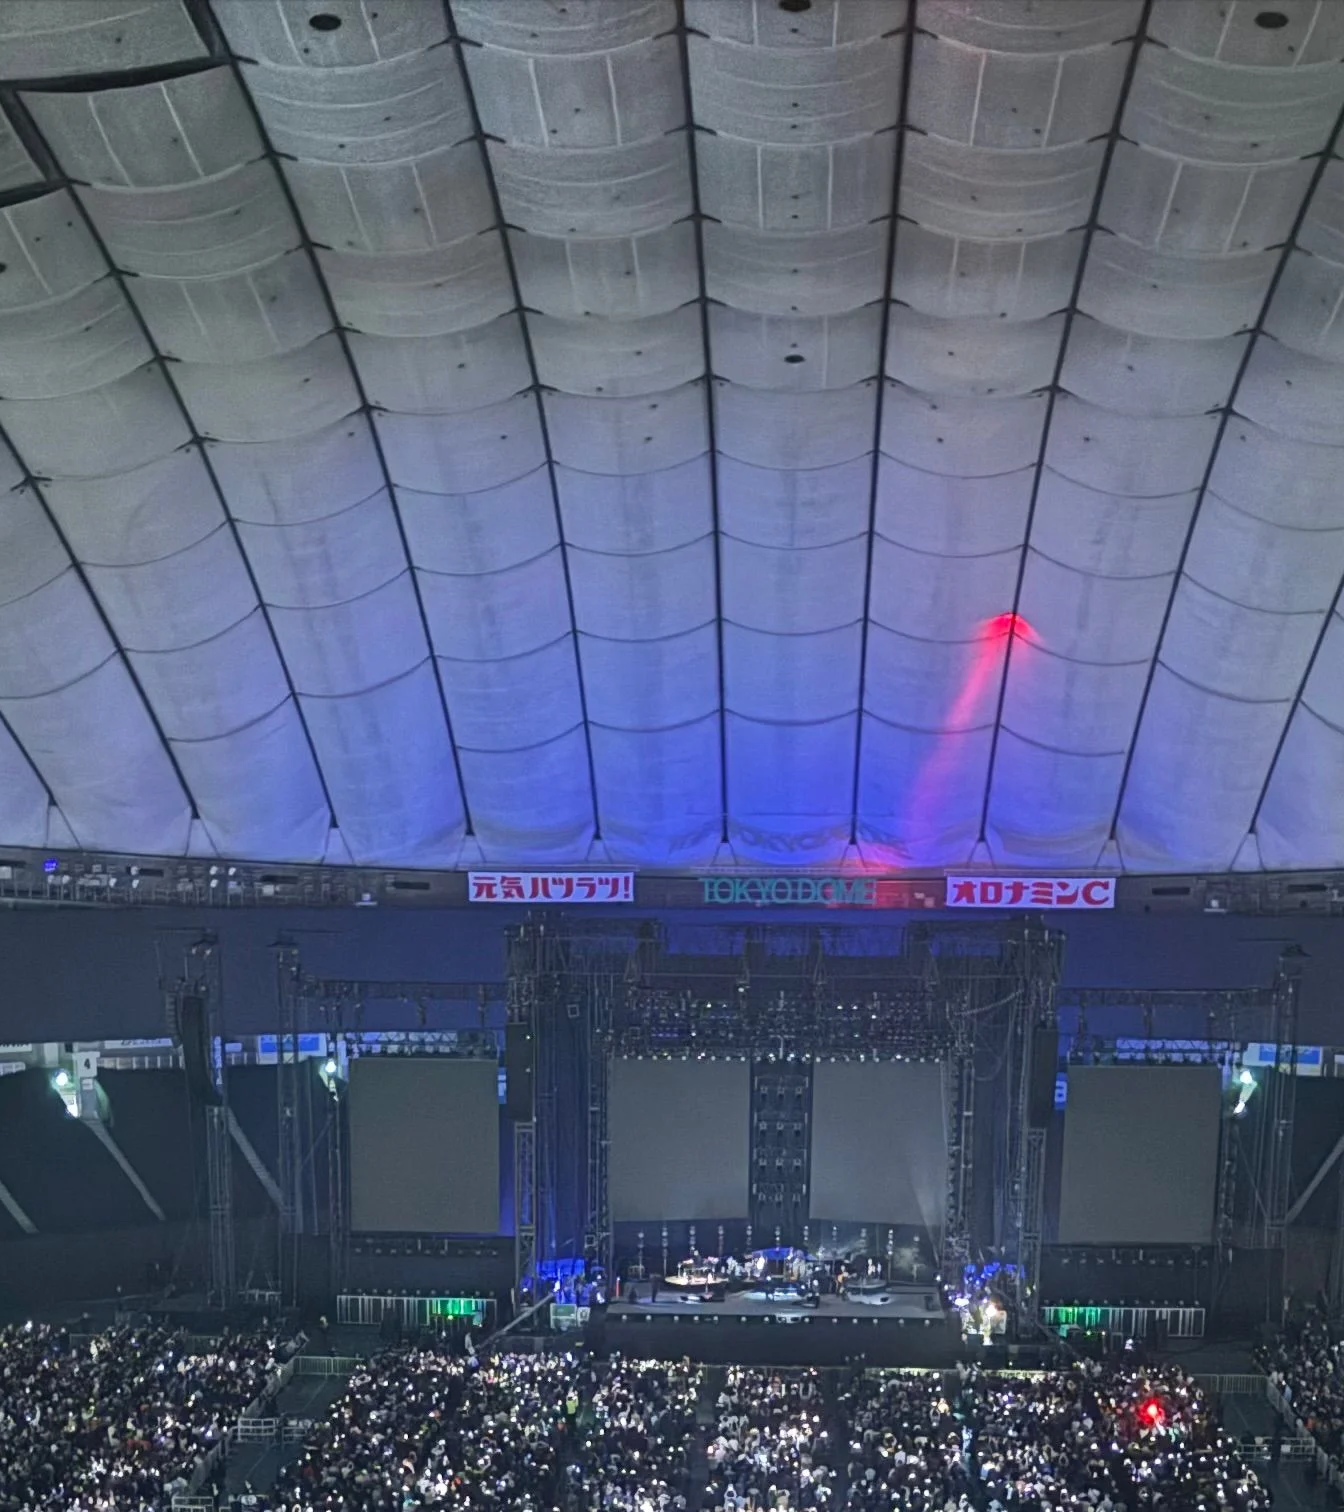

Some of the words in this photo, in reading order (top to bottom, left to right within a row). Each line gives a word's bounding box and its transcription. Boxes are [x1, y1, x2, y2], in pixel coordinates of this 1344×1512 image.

[698, 877, 792, 904] TOKYO
[797, 877, 878, 904] DOME
[952, 880, 1110, 905] オロナミンC
[83, 1058, 91, 1070] 4
